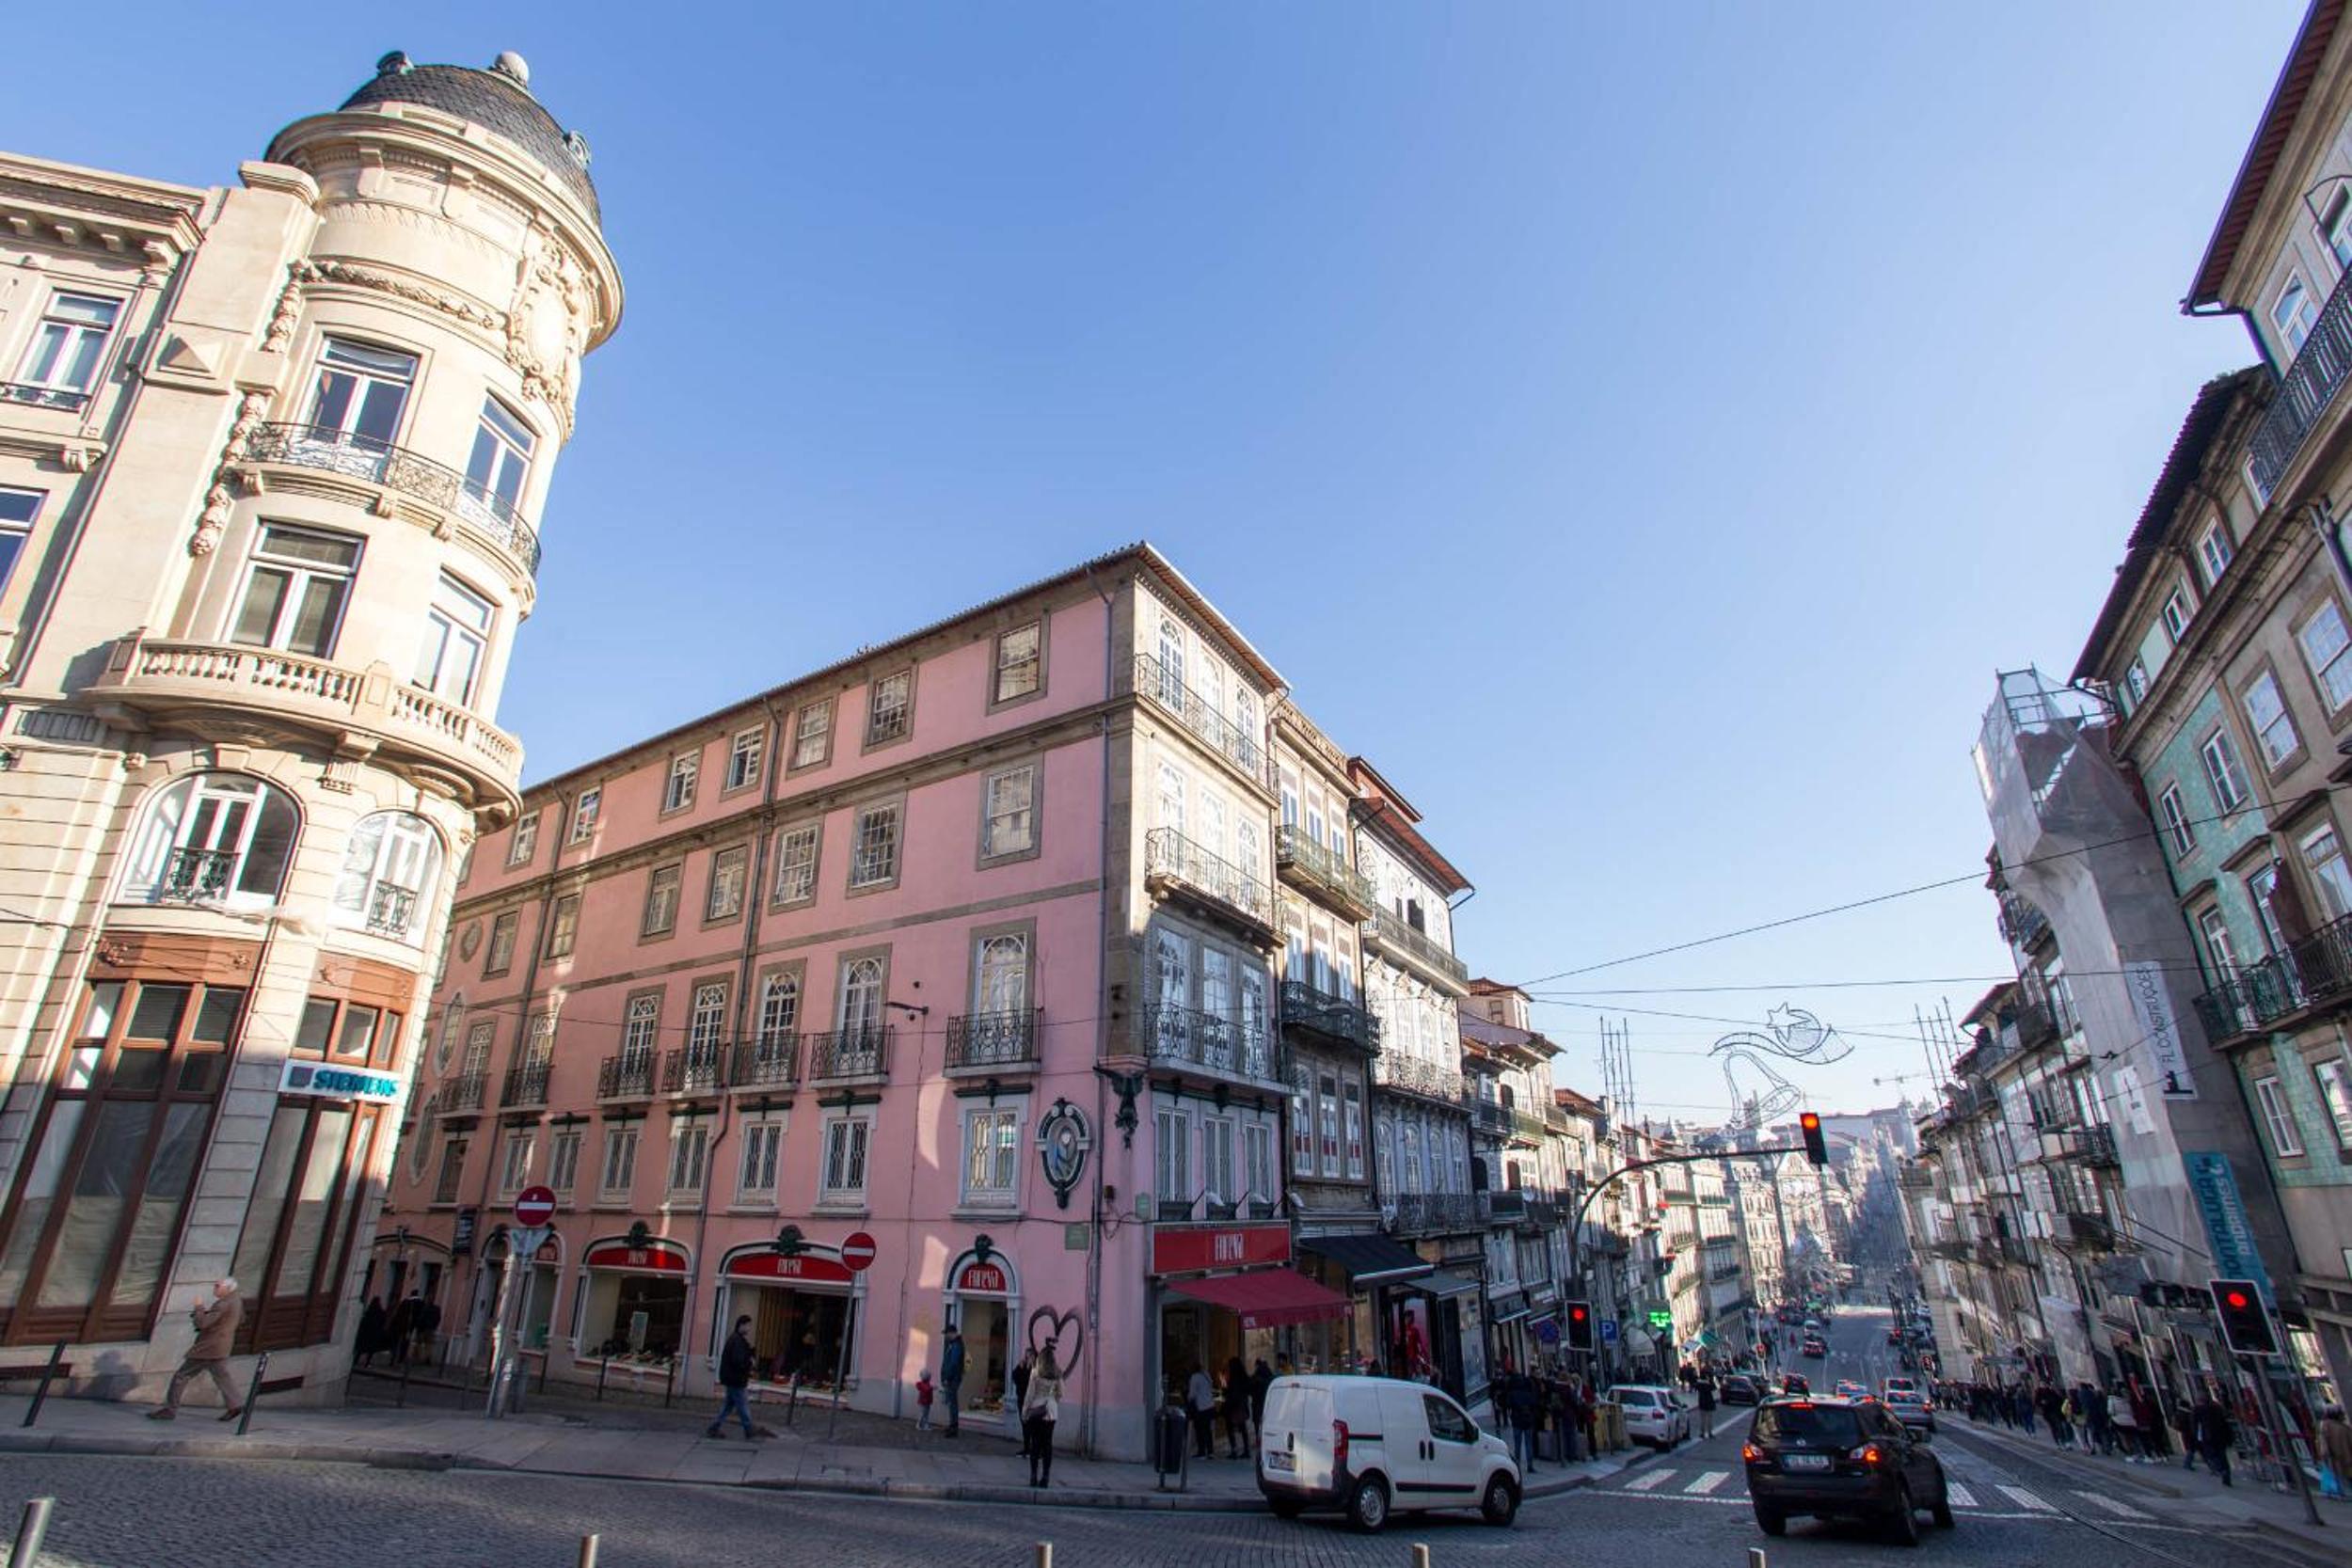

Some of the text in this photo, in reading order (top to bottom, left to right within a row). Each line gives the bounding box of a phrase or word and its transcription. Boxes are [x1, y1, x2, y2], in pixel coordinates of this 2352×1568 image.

[2136, 966, 2172, 1048] CONSTRUÇÕES
[313, 1069, 398, 1097] SIEMENS
[1602, 1323, 1613, 1337] P
